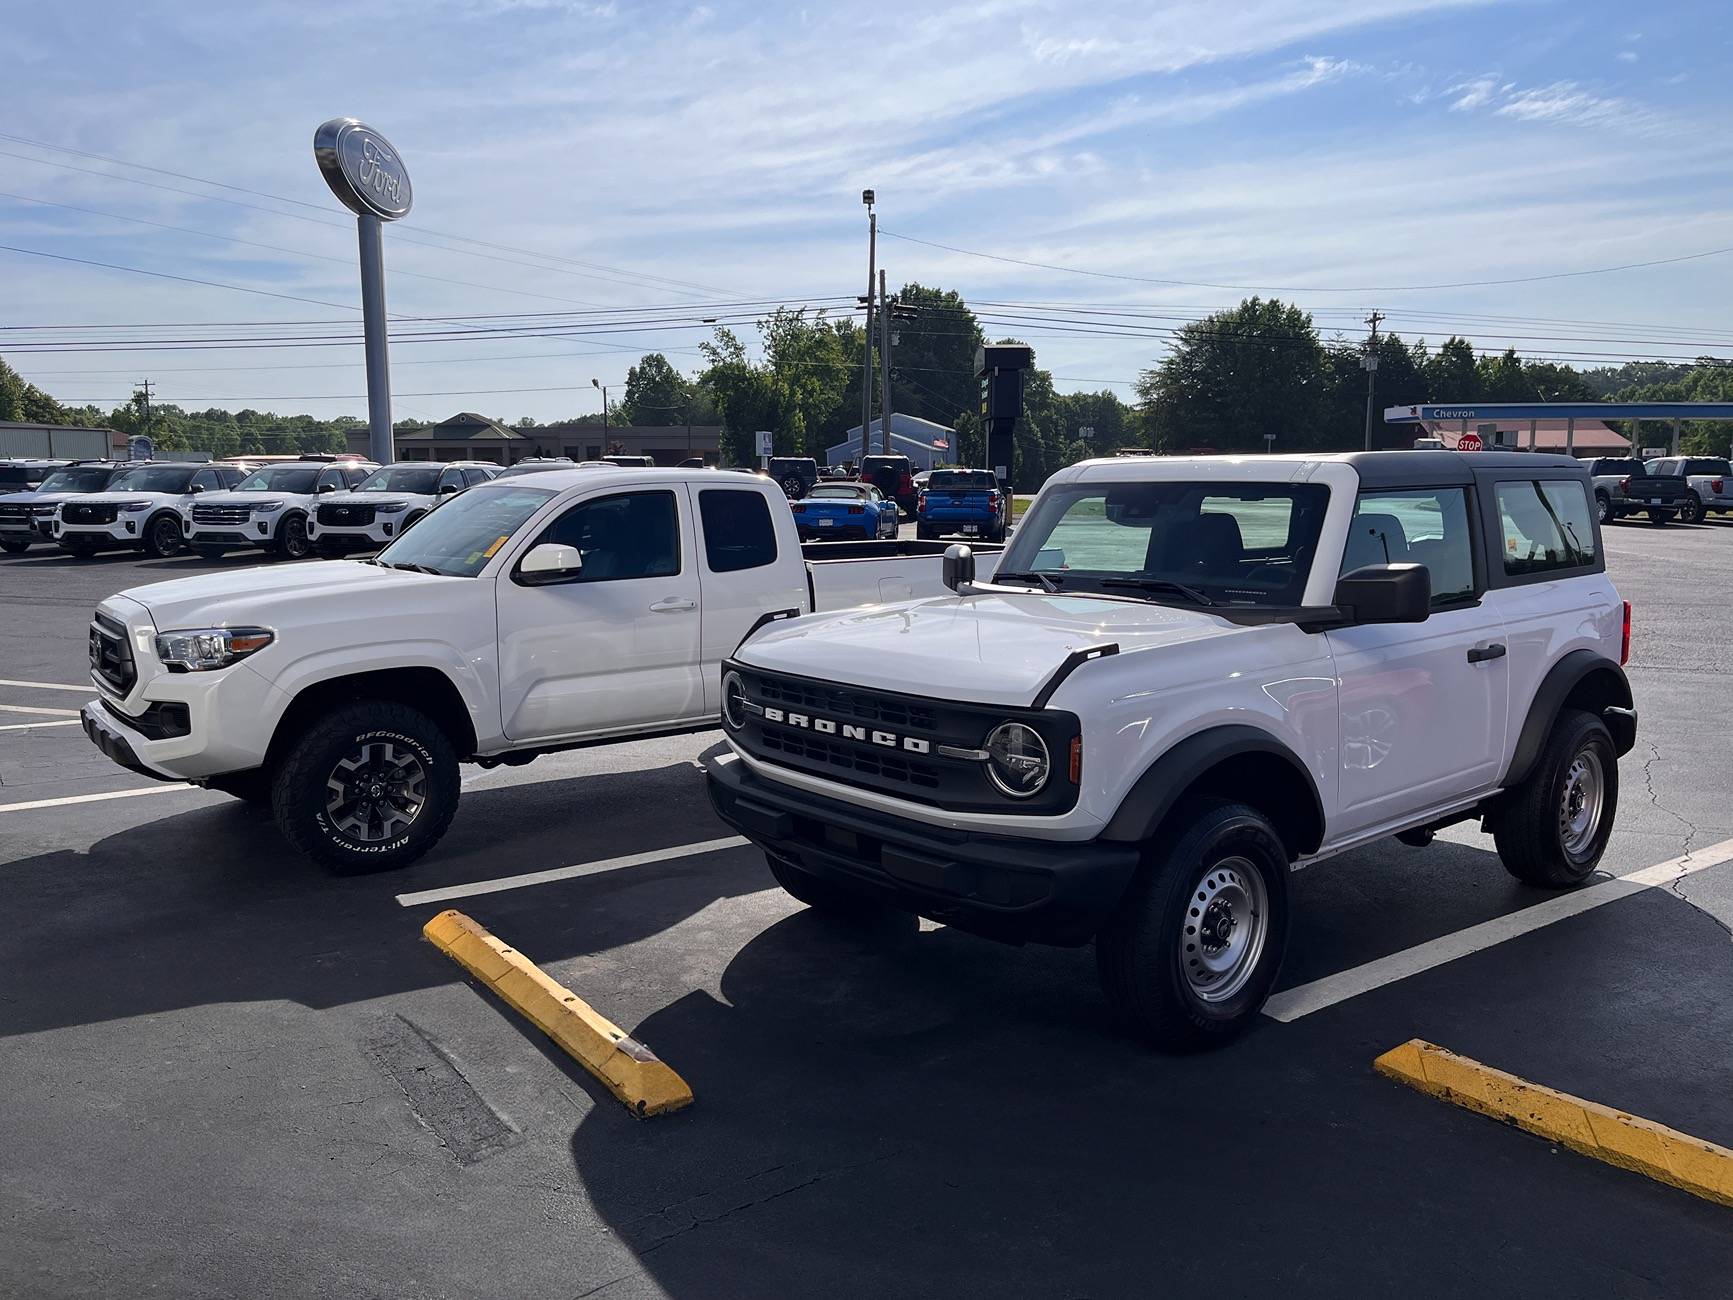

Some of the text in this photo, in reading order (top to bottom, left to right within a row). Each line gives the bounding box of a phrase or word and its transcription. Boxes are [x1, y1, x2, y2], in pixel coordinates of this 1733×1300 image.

[358, 138, 402, 204] Ford
[1433, 409, 1475, 418] Chevron
[1458, 440, 1481, 450] STOP
[764, 707, 930, 754] BRONCO
[355, 730, 434, 765] BFGoodrich
[332, 835, 410, 854] All-Terrain
